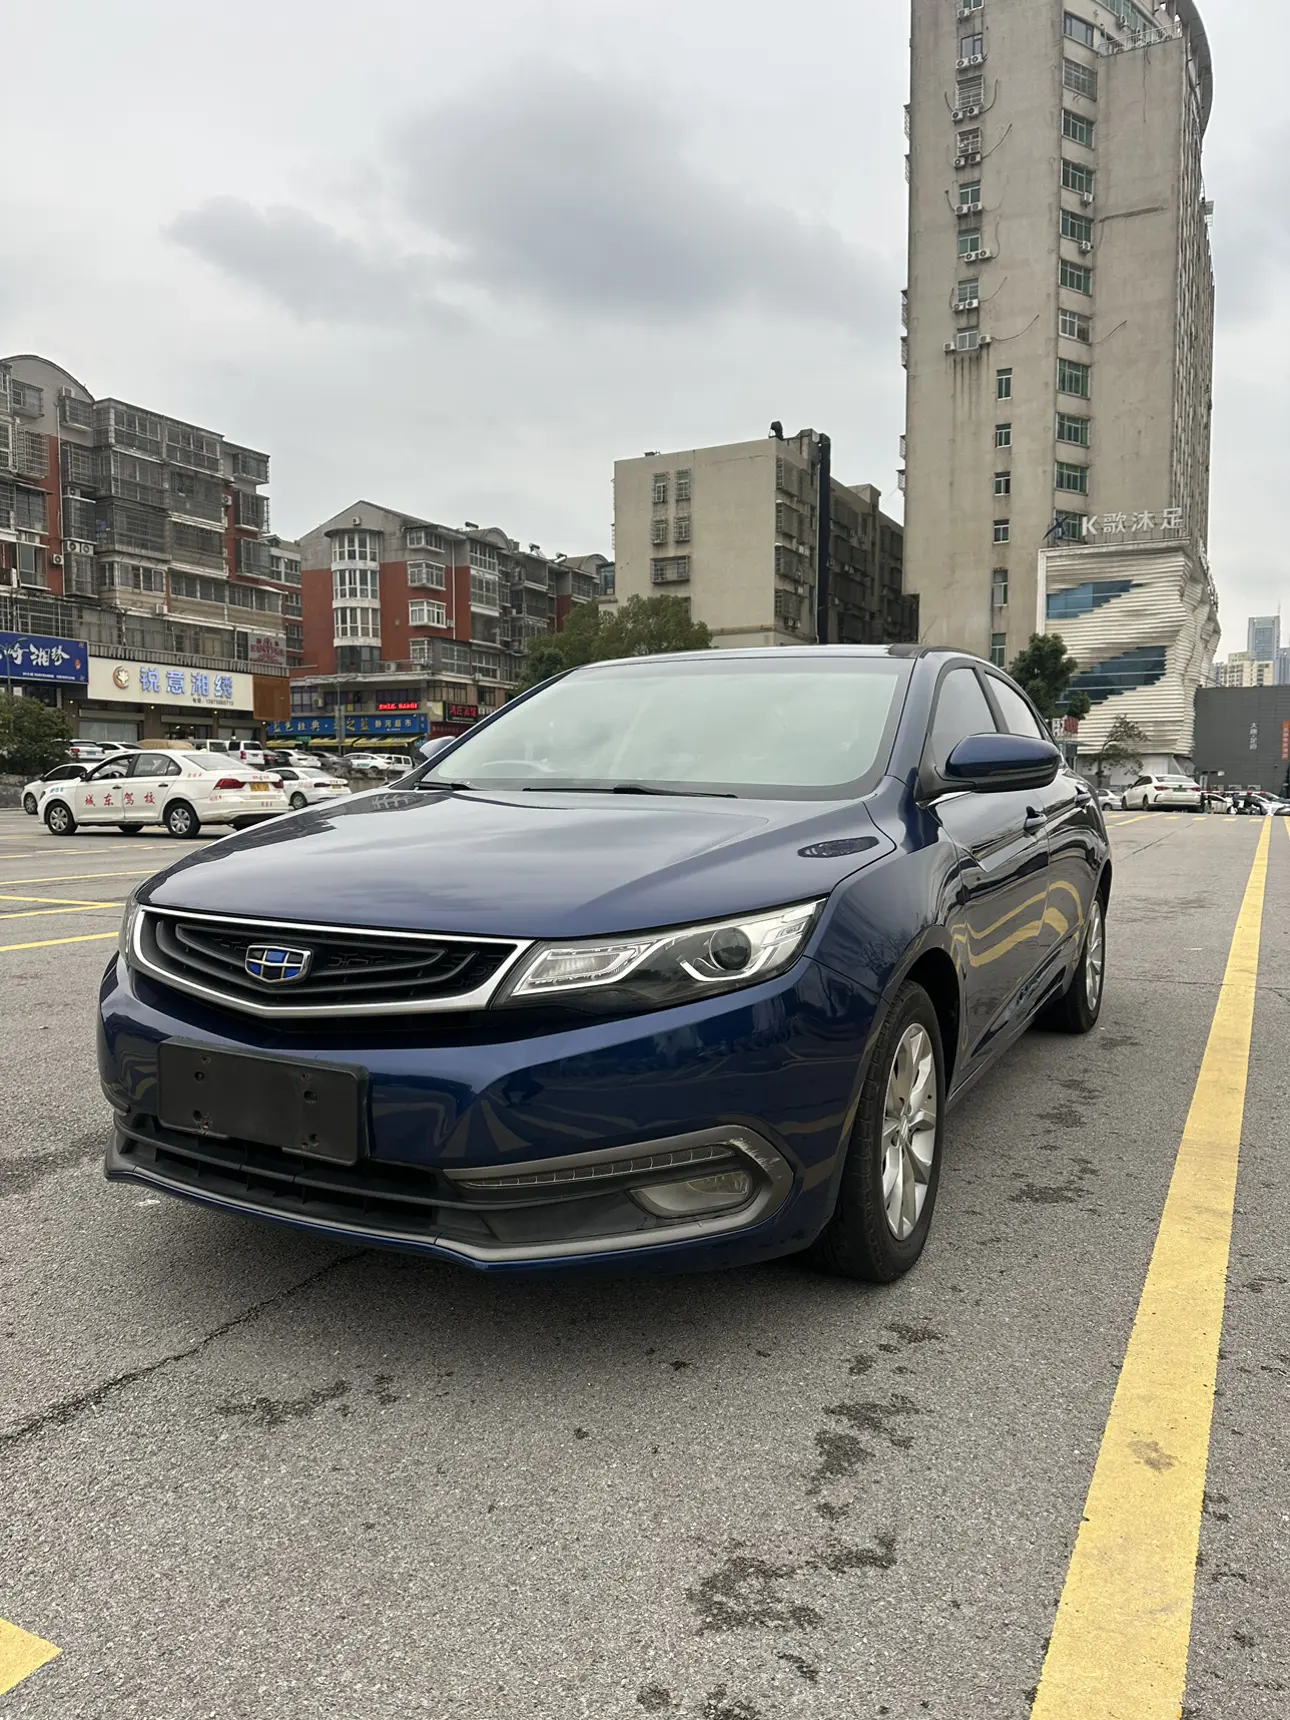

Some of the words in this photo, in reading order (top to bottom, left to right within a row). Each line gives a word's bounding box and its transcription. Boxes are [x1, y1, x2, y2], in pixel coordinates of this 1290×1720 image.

[1082, 506, 1184, 536] K歌沐足
[140, 667, 232, 698] 锐意湘绣
